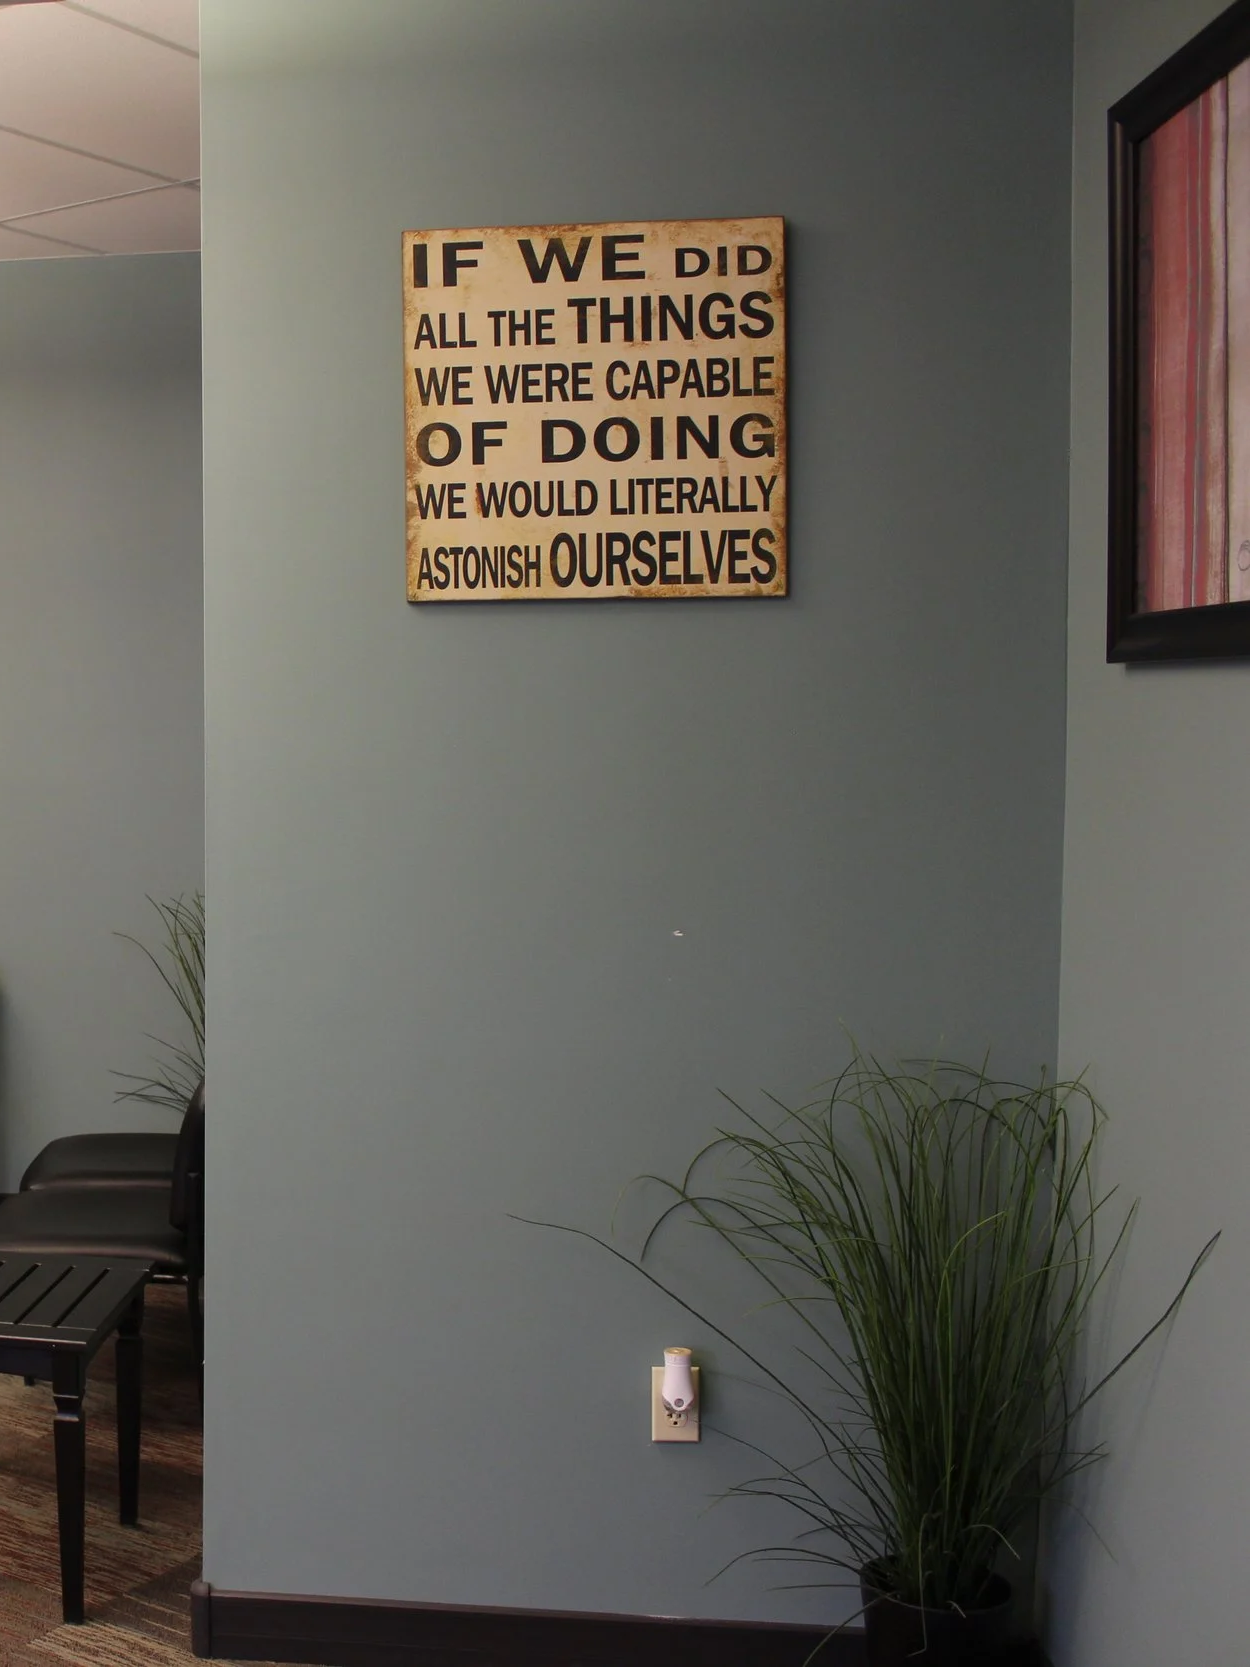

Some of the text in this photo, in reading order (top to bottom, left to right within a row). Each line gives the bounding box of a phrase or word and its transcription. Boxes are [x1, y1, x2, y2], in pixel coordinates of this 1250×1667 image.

[412, 234, 772, 288] IF WE DID
[414, 290, 775, 349] ALL THE THINGS
[414, 355, 775, 406] WE WERE CAPABLE
[415, 412, 776, 466] OF DOING
[415, 475, 778, 520] WE WOULD LITERALLY
[417, 528, 778, 590] ASTONISH OURSELVES
